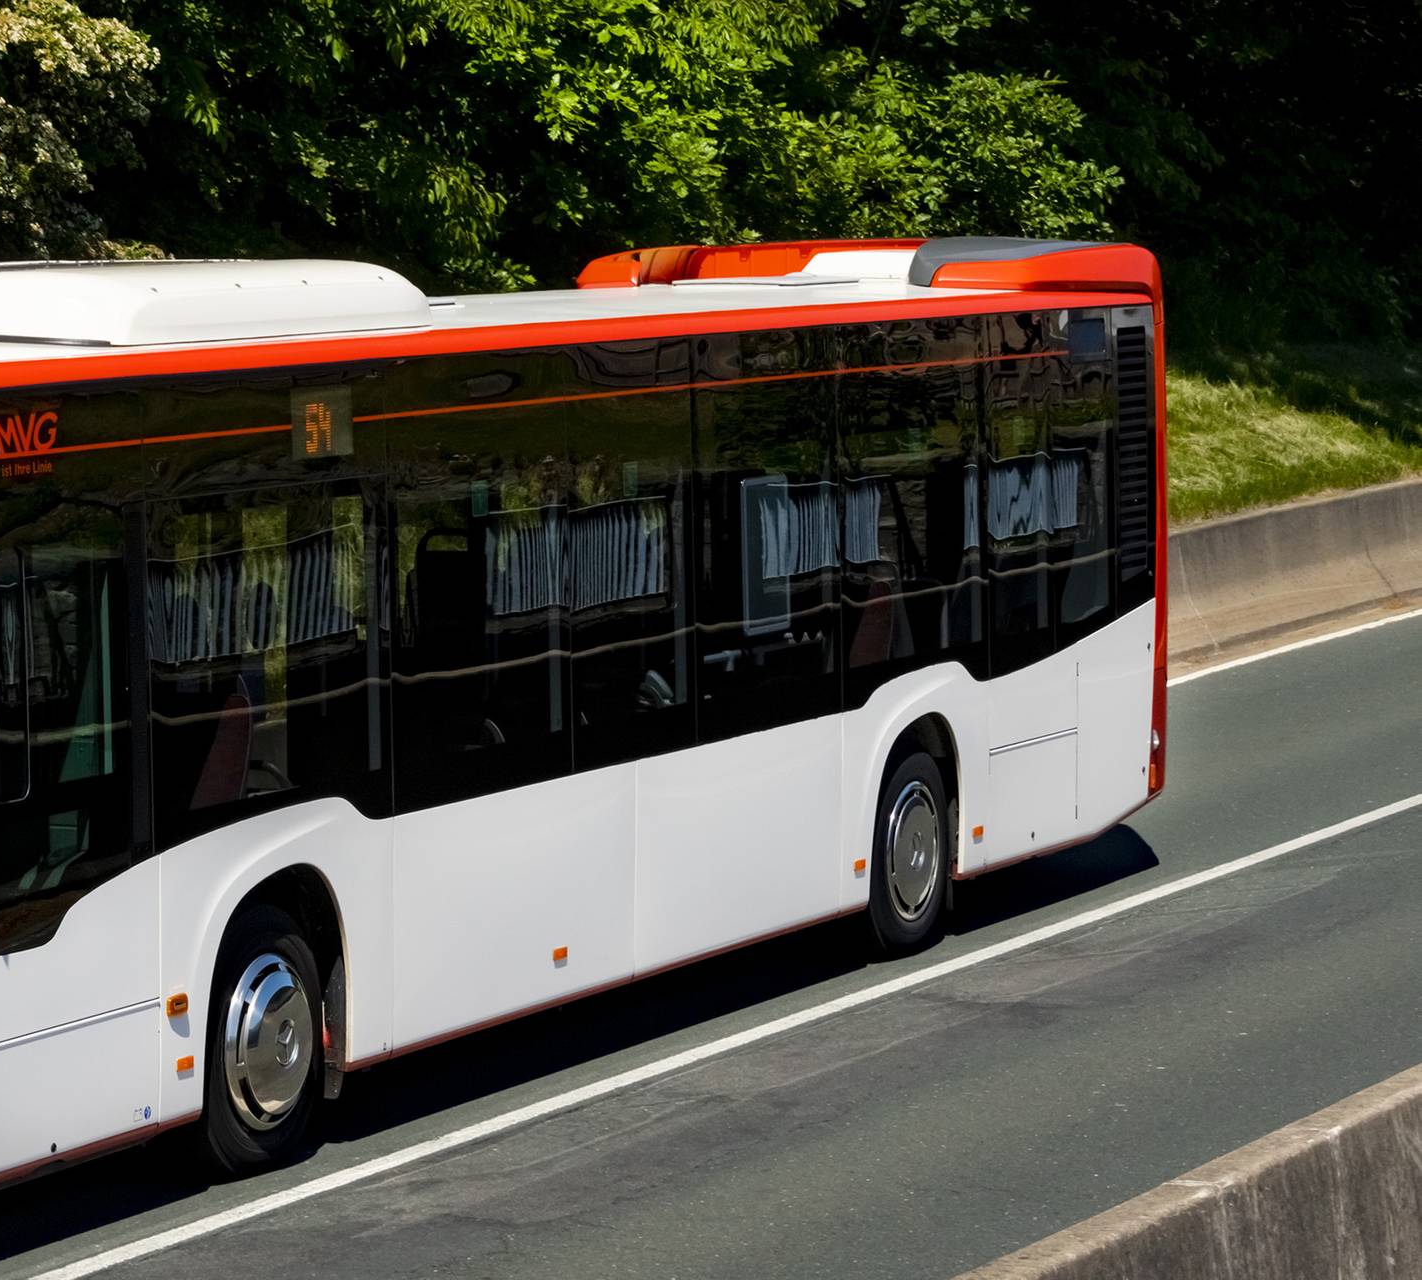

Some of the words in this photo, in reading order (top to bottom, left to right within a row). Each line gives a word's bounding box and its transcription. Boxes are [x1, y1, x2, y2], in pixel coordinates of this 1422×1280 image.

[305, 403, 331, 453] 54
[1, 463, 12, 478] ist
[14, 462, 31, 477] Ihre
